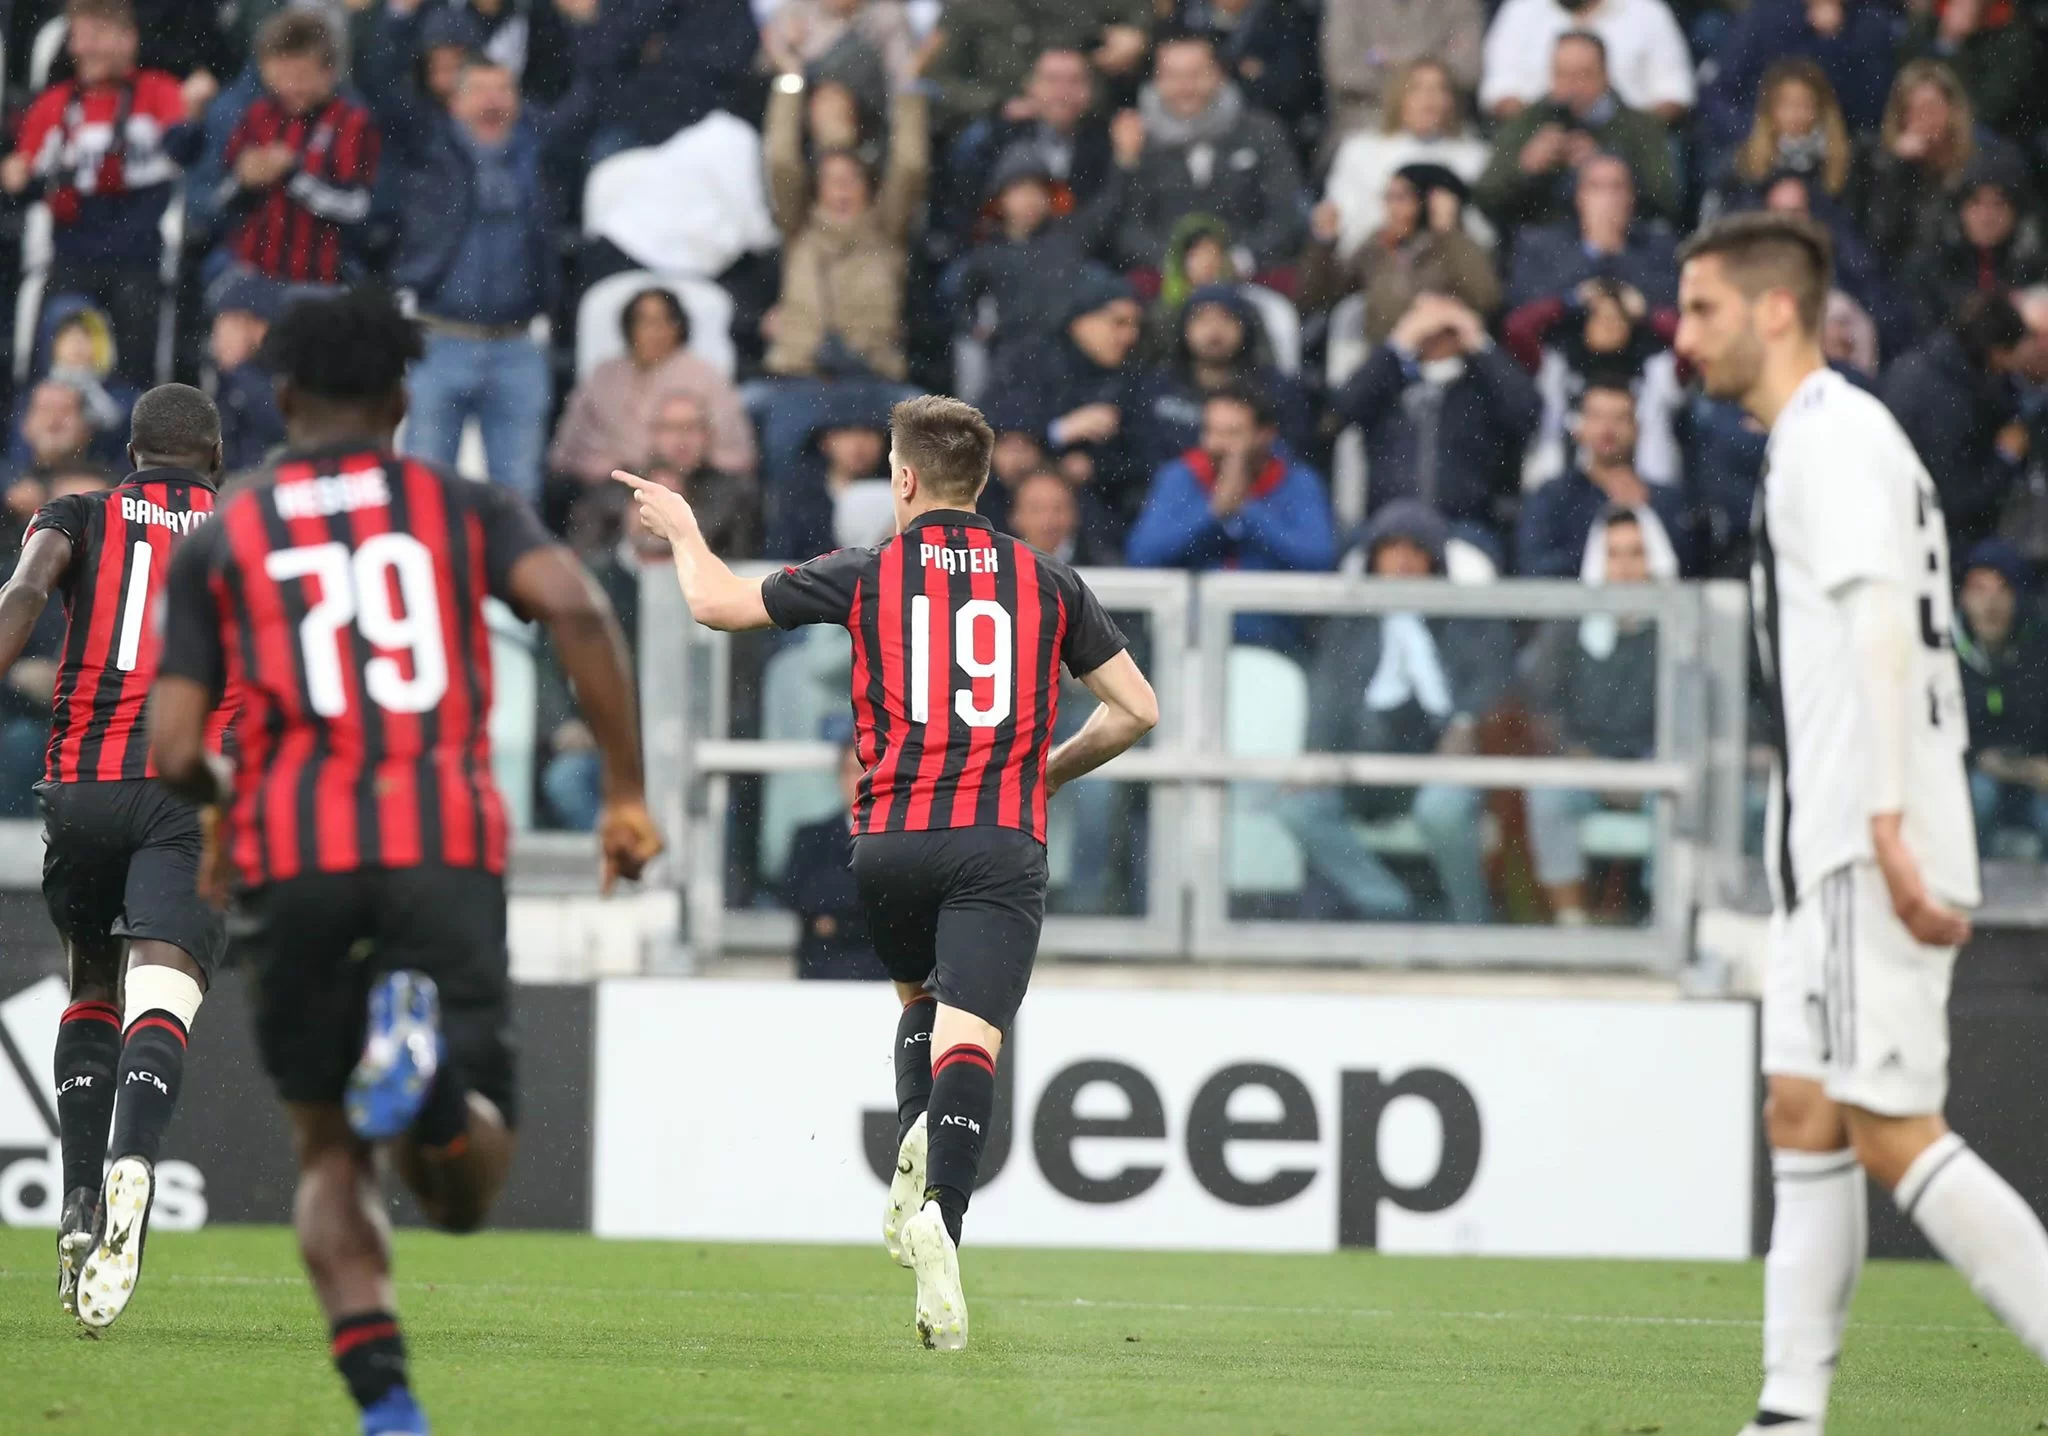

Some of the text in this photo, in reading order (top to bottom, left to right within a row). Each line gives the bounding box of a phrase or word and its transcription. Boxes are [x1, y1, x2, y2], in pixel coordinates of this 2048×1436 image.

[121, 496, 214, 536] BAKAYO
[920, 543, 998, 575] PIĄTEK
[265, 532, 449, 718] 79
[911, 594, 1011, 727] 19
[125, 1071, 167, 1095] ACM
[940, 1114, 980, 1135] ACM
